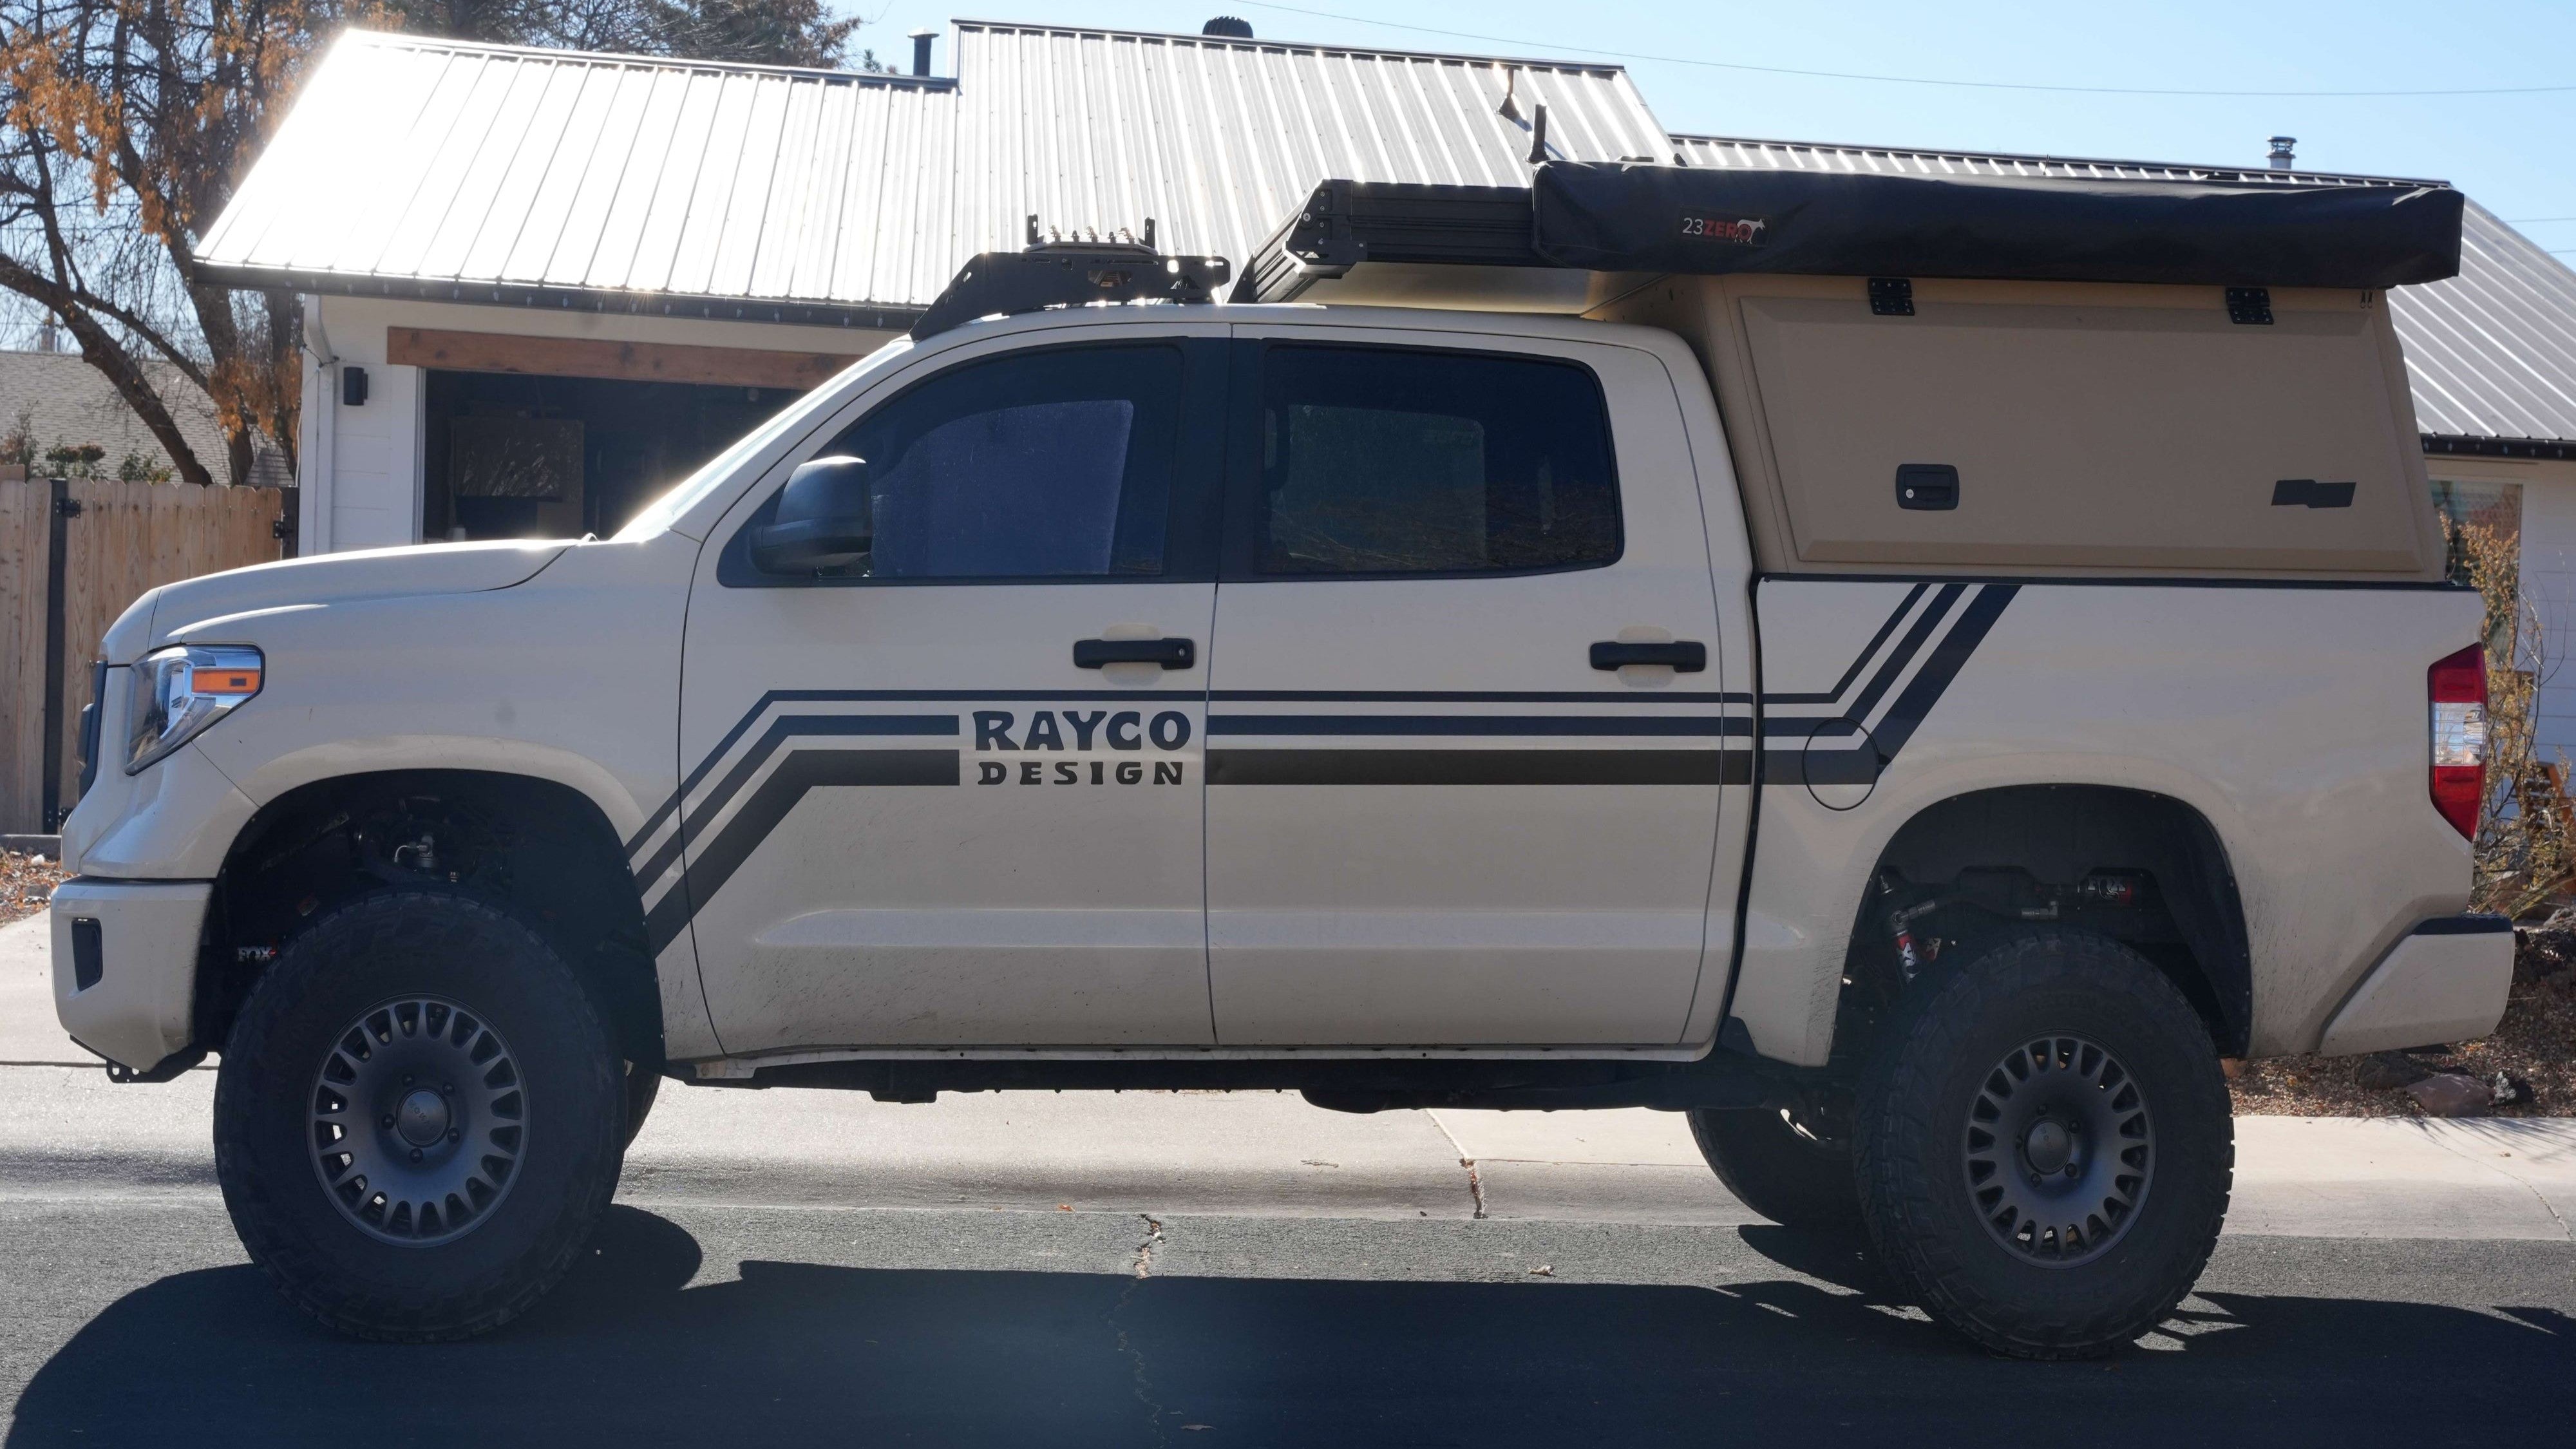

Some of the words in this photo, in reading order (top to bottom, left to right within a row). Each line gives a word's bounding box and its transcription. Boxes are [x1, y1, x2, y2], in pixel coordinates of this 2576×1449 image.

[1682, 217, 1752, 240] 23ZERO
[972, 711, 1191, 751] RAYCO
[978, 762, 1183, 786] DESIGN
[2088, 876, 2126, 895] FOX
[237, 946, 271, 961] FOX
